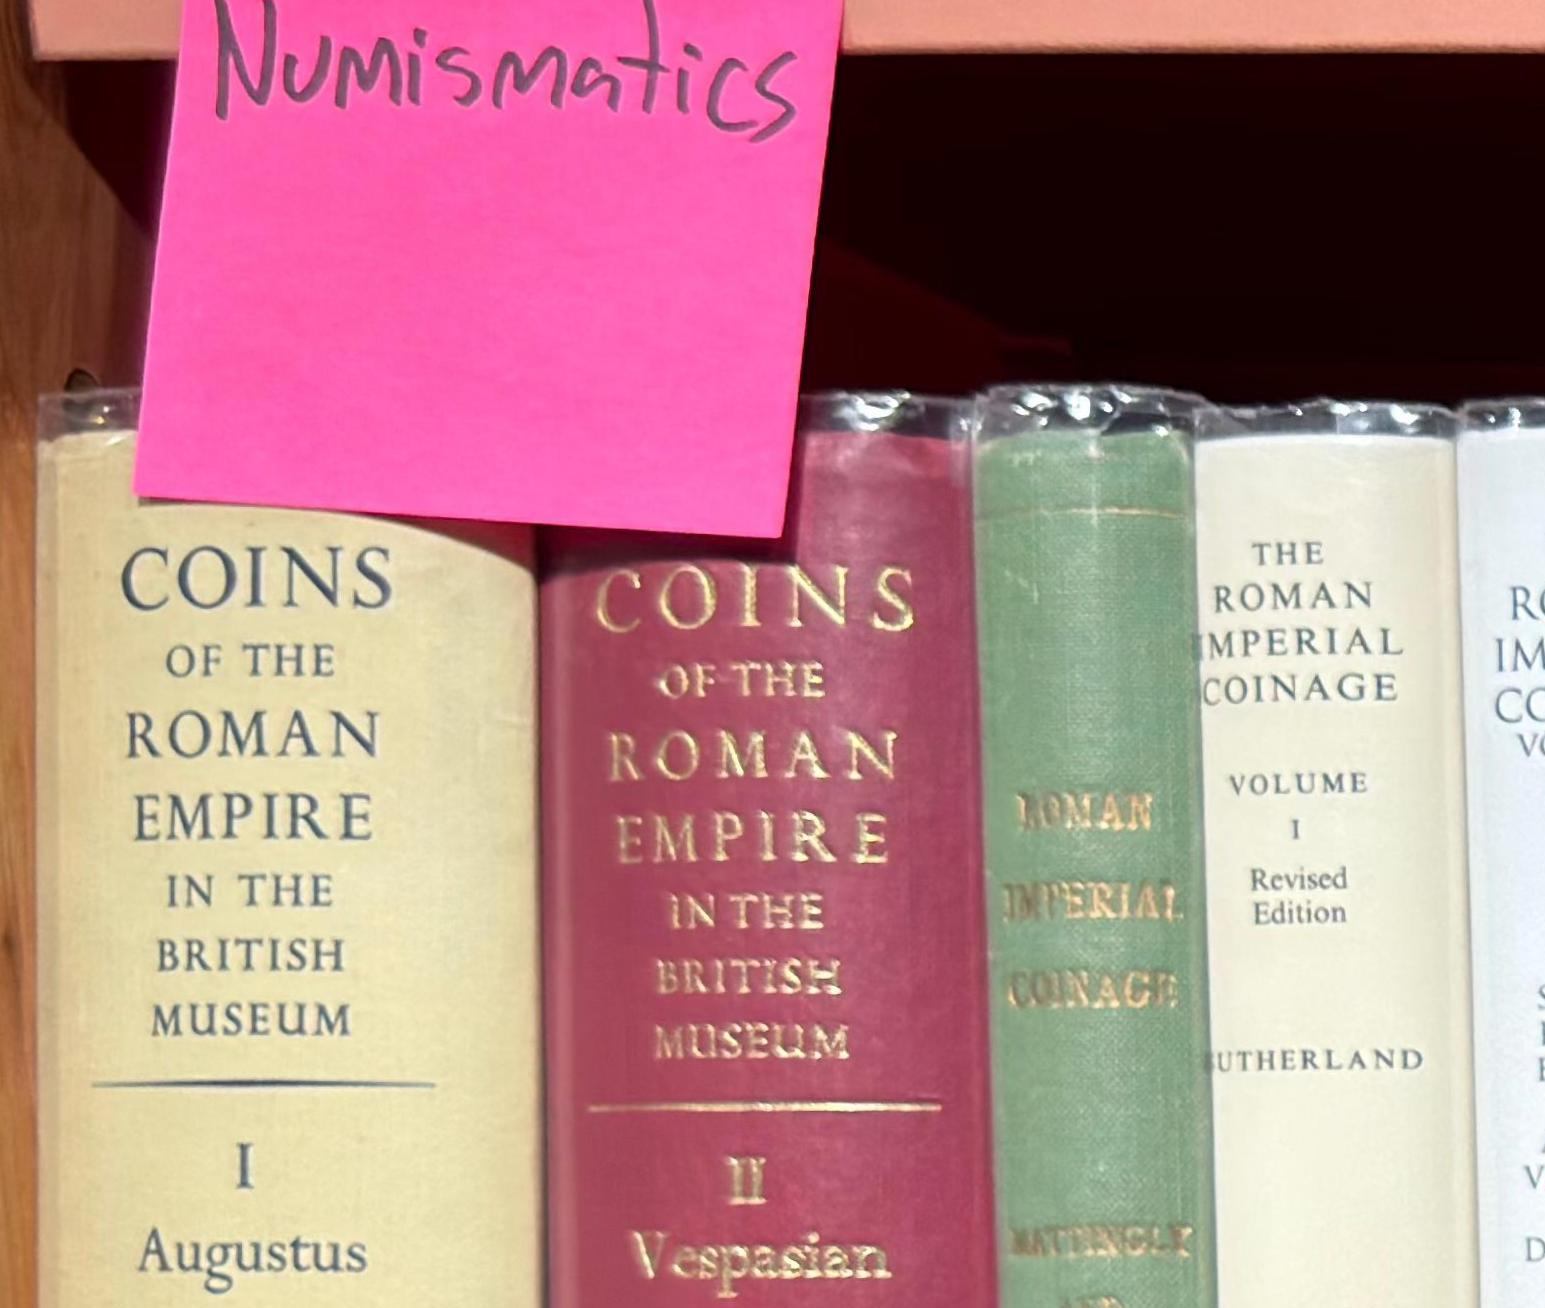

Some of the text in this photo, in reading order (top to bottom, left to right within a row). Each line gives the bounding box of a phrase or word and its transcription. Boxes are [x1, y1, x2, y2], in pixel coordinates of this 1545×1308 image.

[213, 0, 798, 144] Numismatics
[1251, 541, 1325, 567] THE
[121, 545, 393, 612] COINS
[596, 562, 916, 634] COINS
[1214, 580, 1374, 614] ROMAN
[165, 644, 336, 678] OF THE
[656, 660, 826, 700] OF THE
[1202, 672, 1398, 707] COINAGE
[126, 710, 380, 760] ROMAN
[608, 729, 899, 782] ROMAN
[1229, 771, 1368, 797] VOLUME
[132, 793, 374, 842] EMPIRE
[615, 809, 890, 865] EMPIRE
[1290, 818, 1301, 840] I
[166, 873, 334, 907] IN THE
[1249, 866, 1349, 893] Revised
[669, 892, 825, 931] IN THE
[1252, 901, 1348, 927] Edition
[156, 938, 346, 973] BRITISH
[654, 959, 842, 997] BRITISH
[1007, 968, 1181, 1010] COINAGE
[150, 1002, 352, 1037] MUSEUM
[653, 1022, 851, 1062] MUSEUM
[236, 1142, 255, 1190] I
[724, 1155, 767, 1206] II
[137, 1226, 369, 1294] Augustus
[631, 1229, 893, 1299] Vespasian
